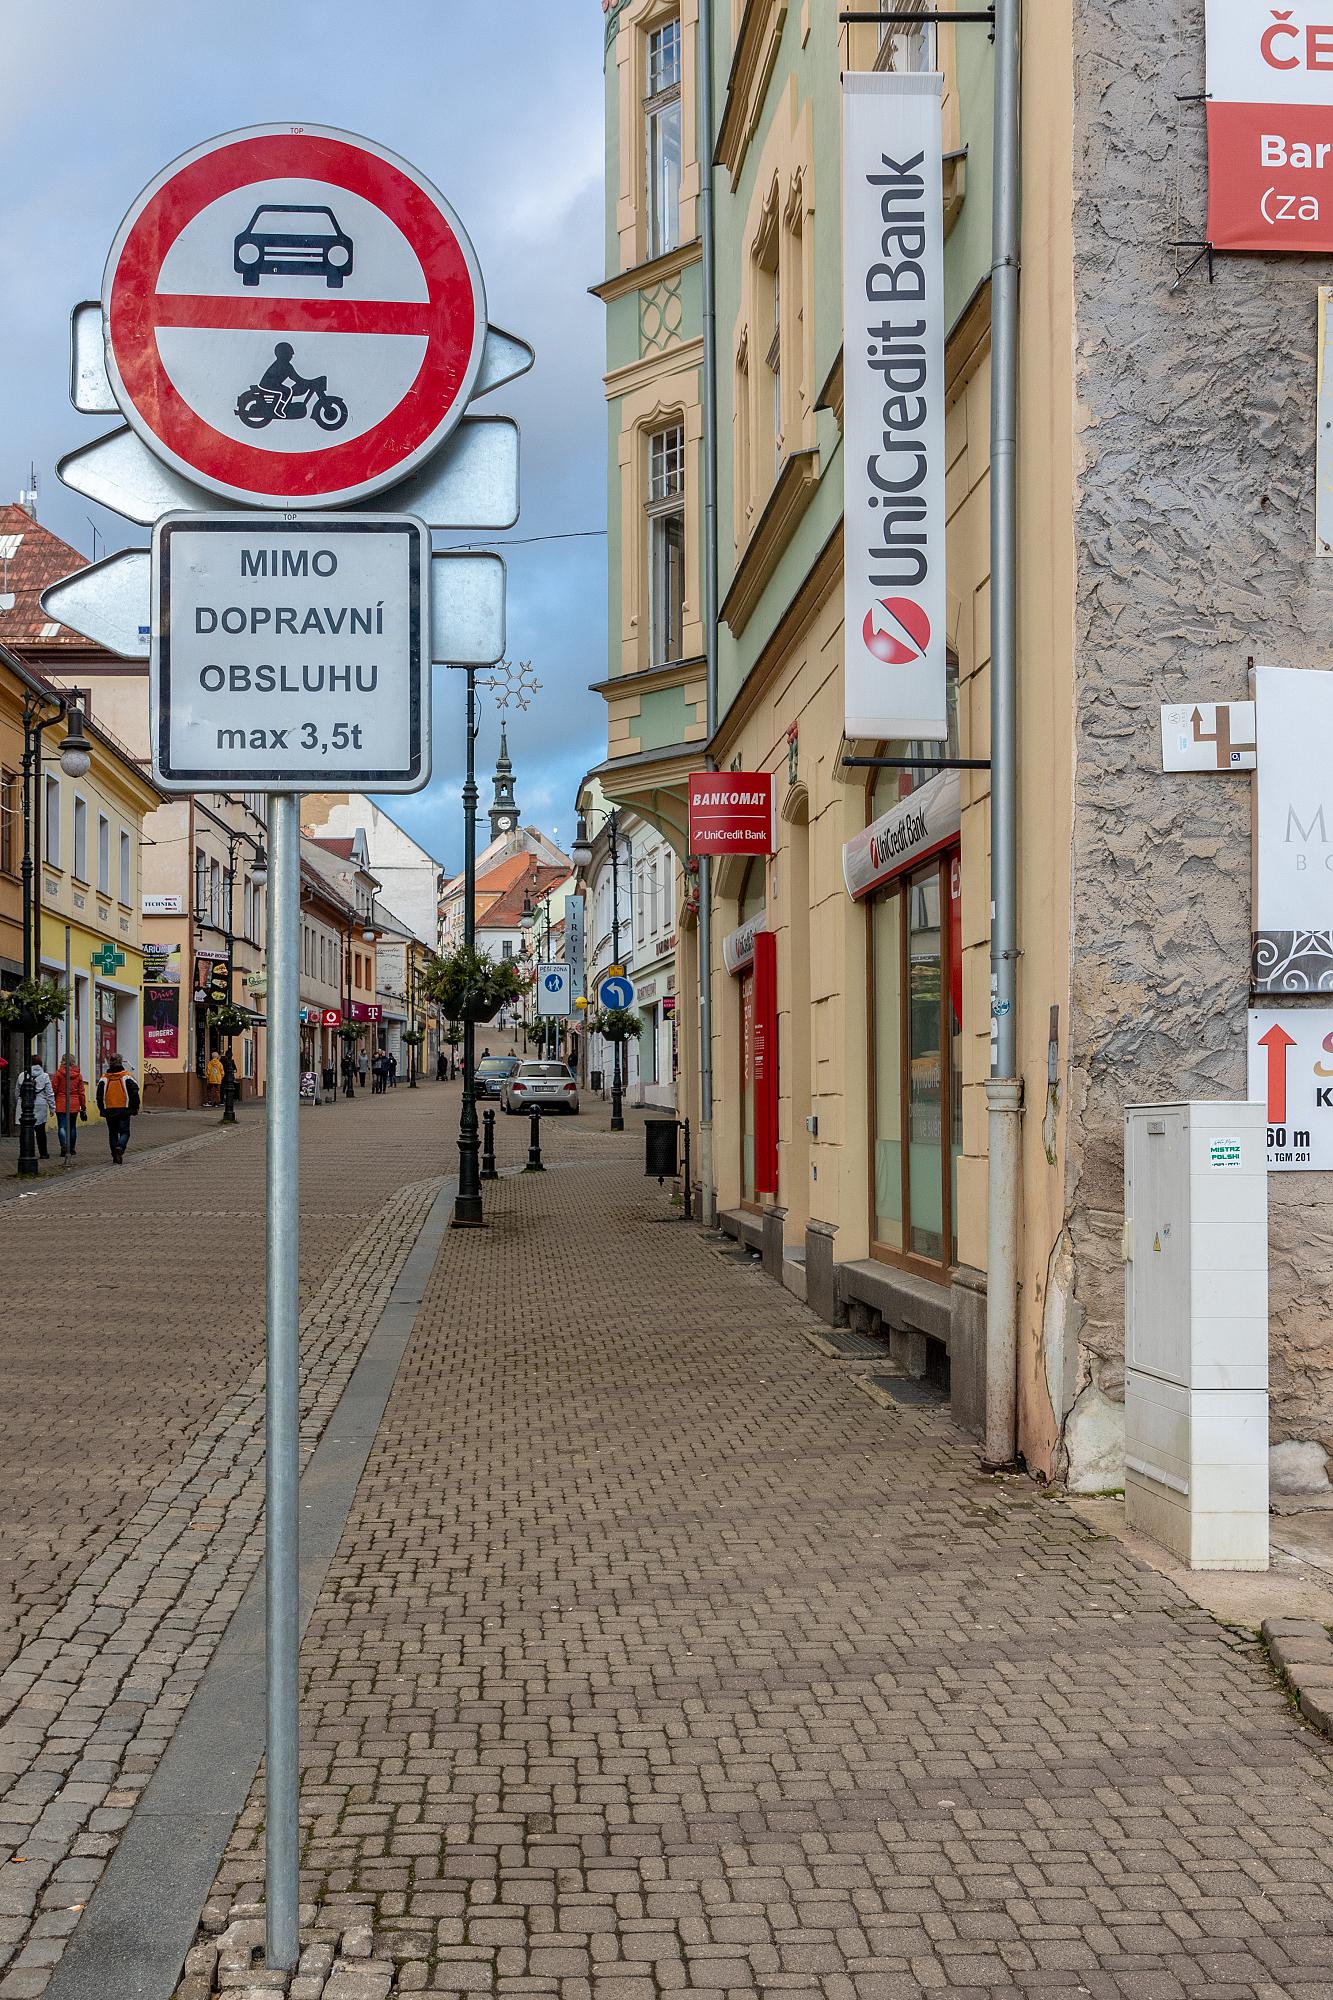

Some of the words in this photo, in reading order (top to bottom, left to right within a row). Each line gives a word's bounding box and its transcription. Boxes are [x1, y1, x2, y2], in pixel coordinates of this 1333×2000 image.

[1261, 134, 1333, 169] Bar
[1261, 186, 1319, 225] (za
[865, 150, 926, 302] Bank
[866, 320, 928, 587] UniCredit
[240, 549, 338, 578] MIMO
[195, 600, 385, 635] DOPRAVNÍ
[199, 664, 378, 693] OBSLUHU
[217, 729, 289, 750] max
[300, 722, 363, 755] 3,5t
[693, 792, 766, 806] BANKOMAT
[704, 830, 744, 840] UniCredit
[745, 829, 767, 840] Bank
[876, 817, 909, 864] UniCredit
[906, 806, 929, 846] Bank
[570, 901, 578, 987] VIRGINIA
[148, 1029, 174, 1038] BURGERS
[1267, 1127, 1287, 1148] 60
[1293, 1130, 1310, 1148] m
[1275, 1153, 1293, 1162] TGM
[1295, 1153, 1311, 1162] 201
